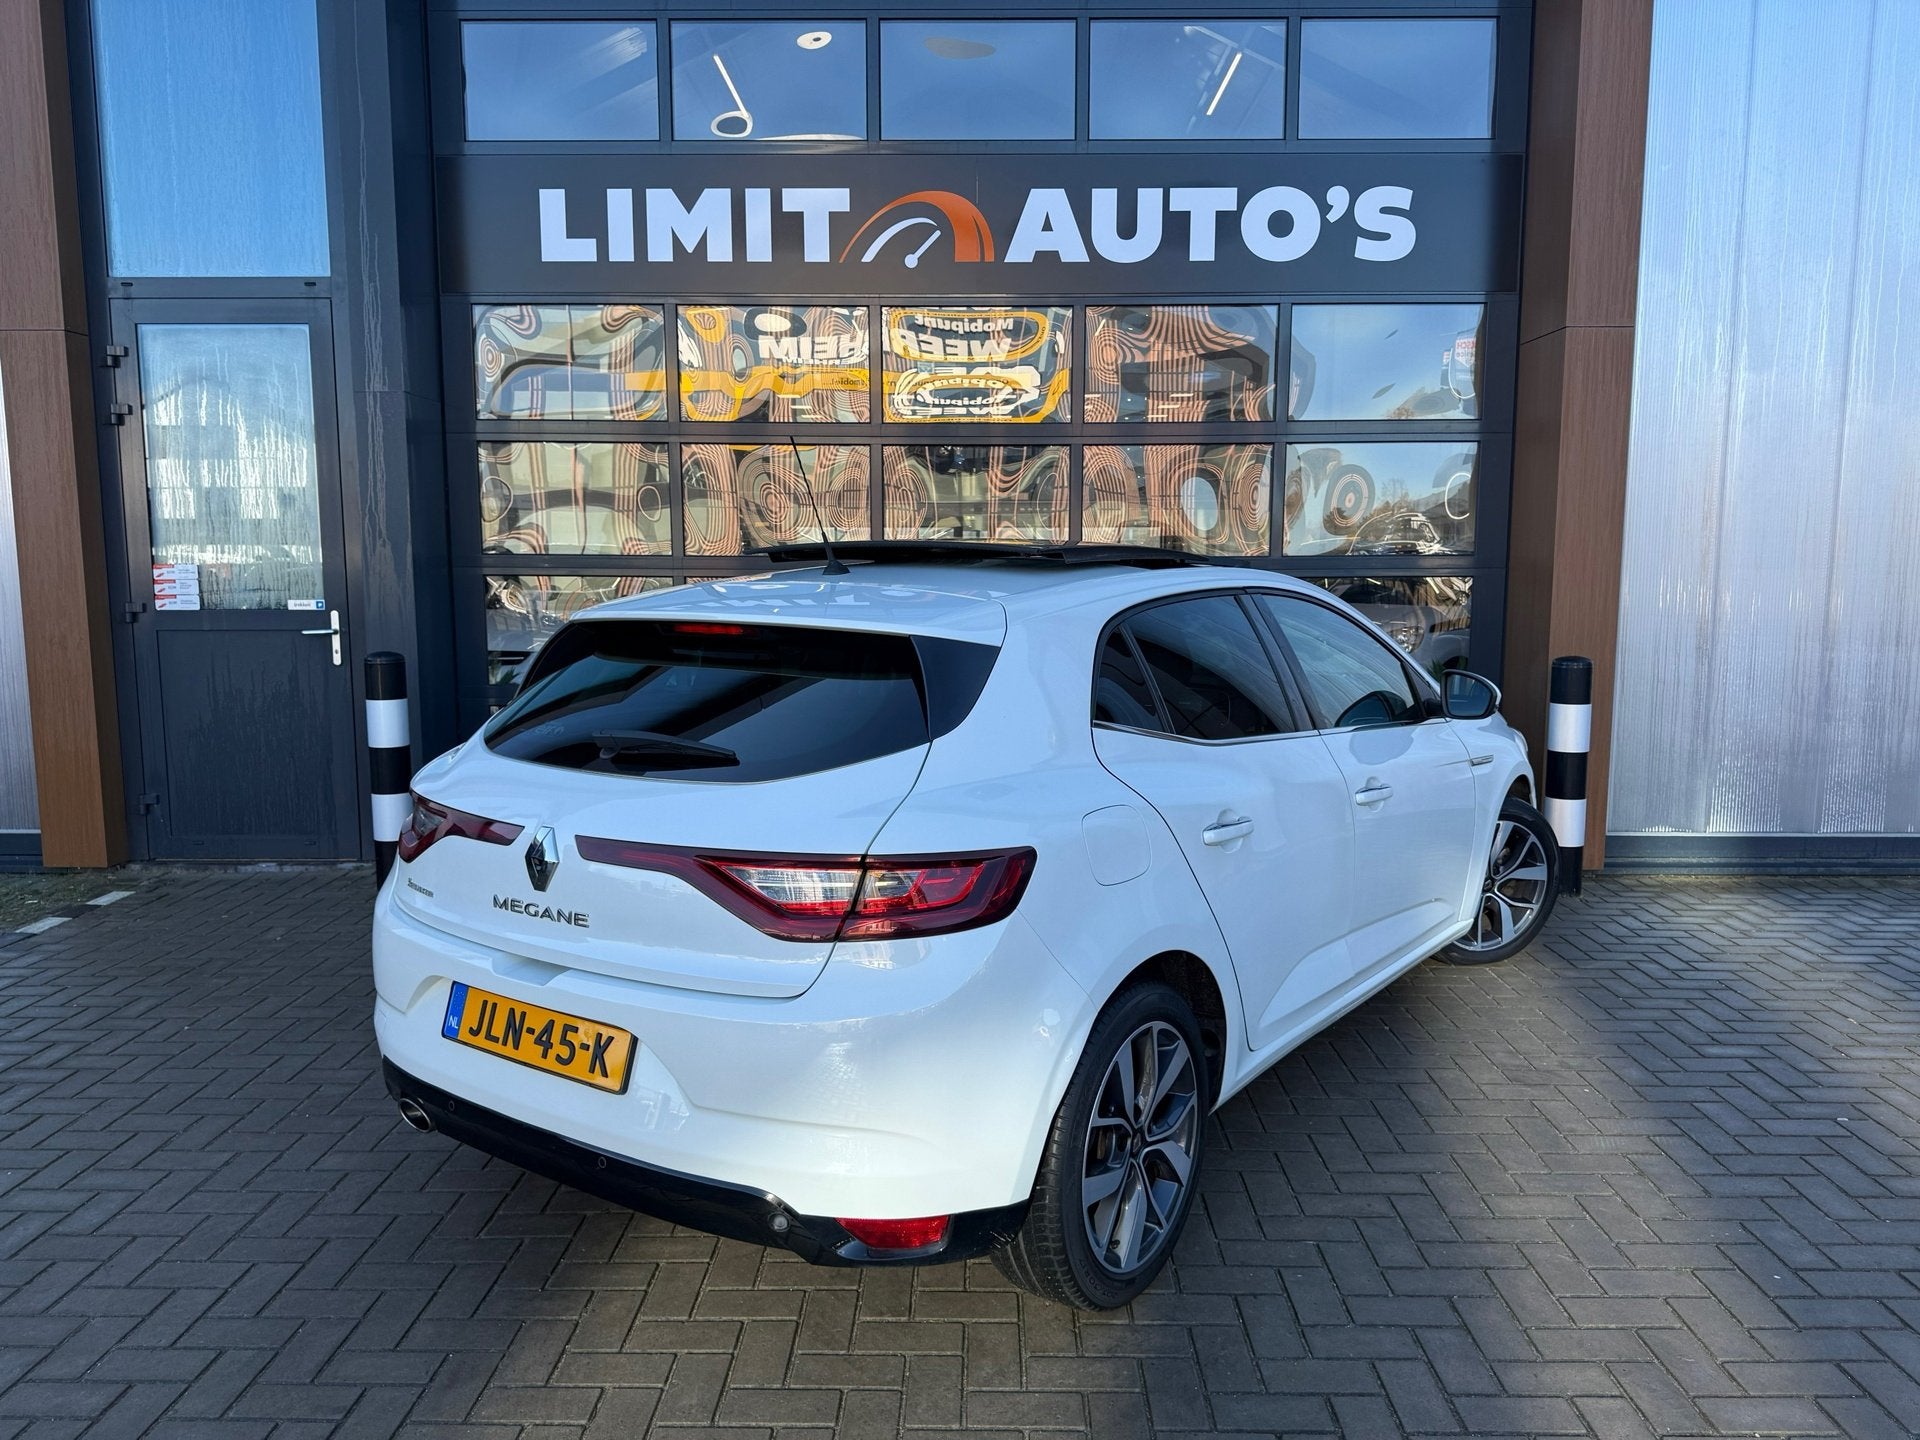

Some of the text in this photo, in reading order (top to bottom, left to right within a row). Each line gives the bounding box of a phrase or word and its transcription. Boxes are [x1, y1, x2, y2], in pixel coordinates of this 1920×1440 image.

[538, 185, 1418, 264] LIMIT AUTO'S
[493, 894, 590, 929] MEGANE
[448, 1014, 459, 1029] NL
[468, 999, 615, 1079] JLN-45-K
